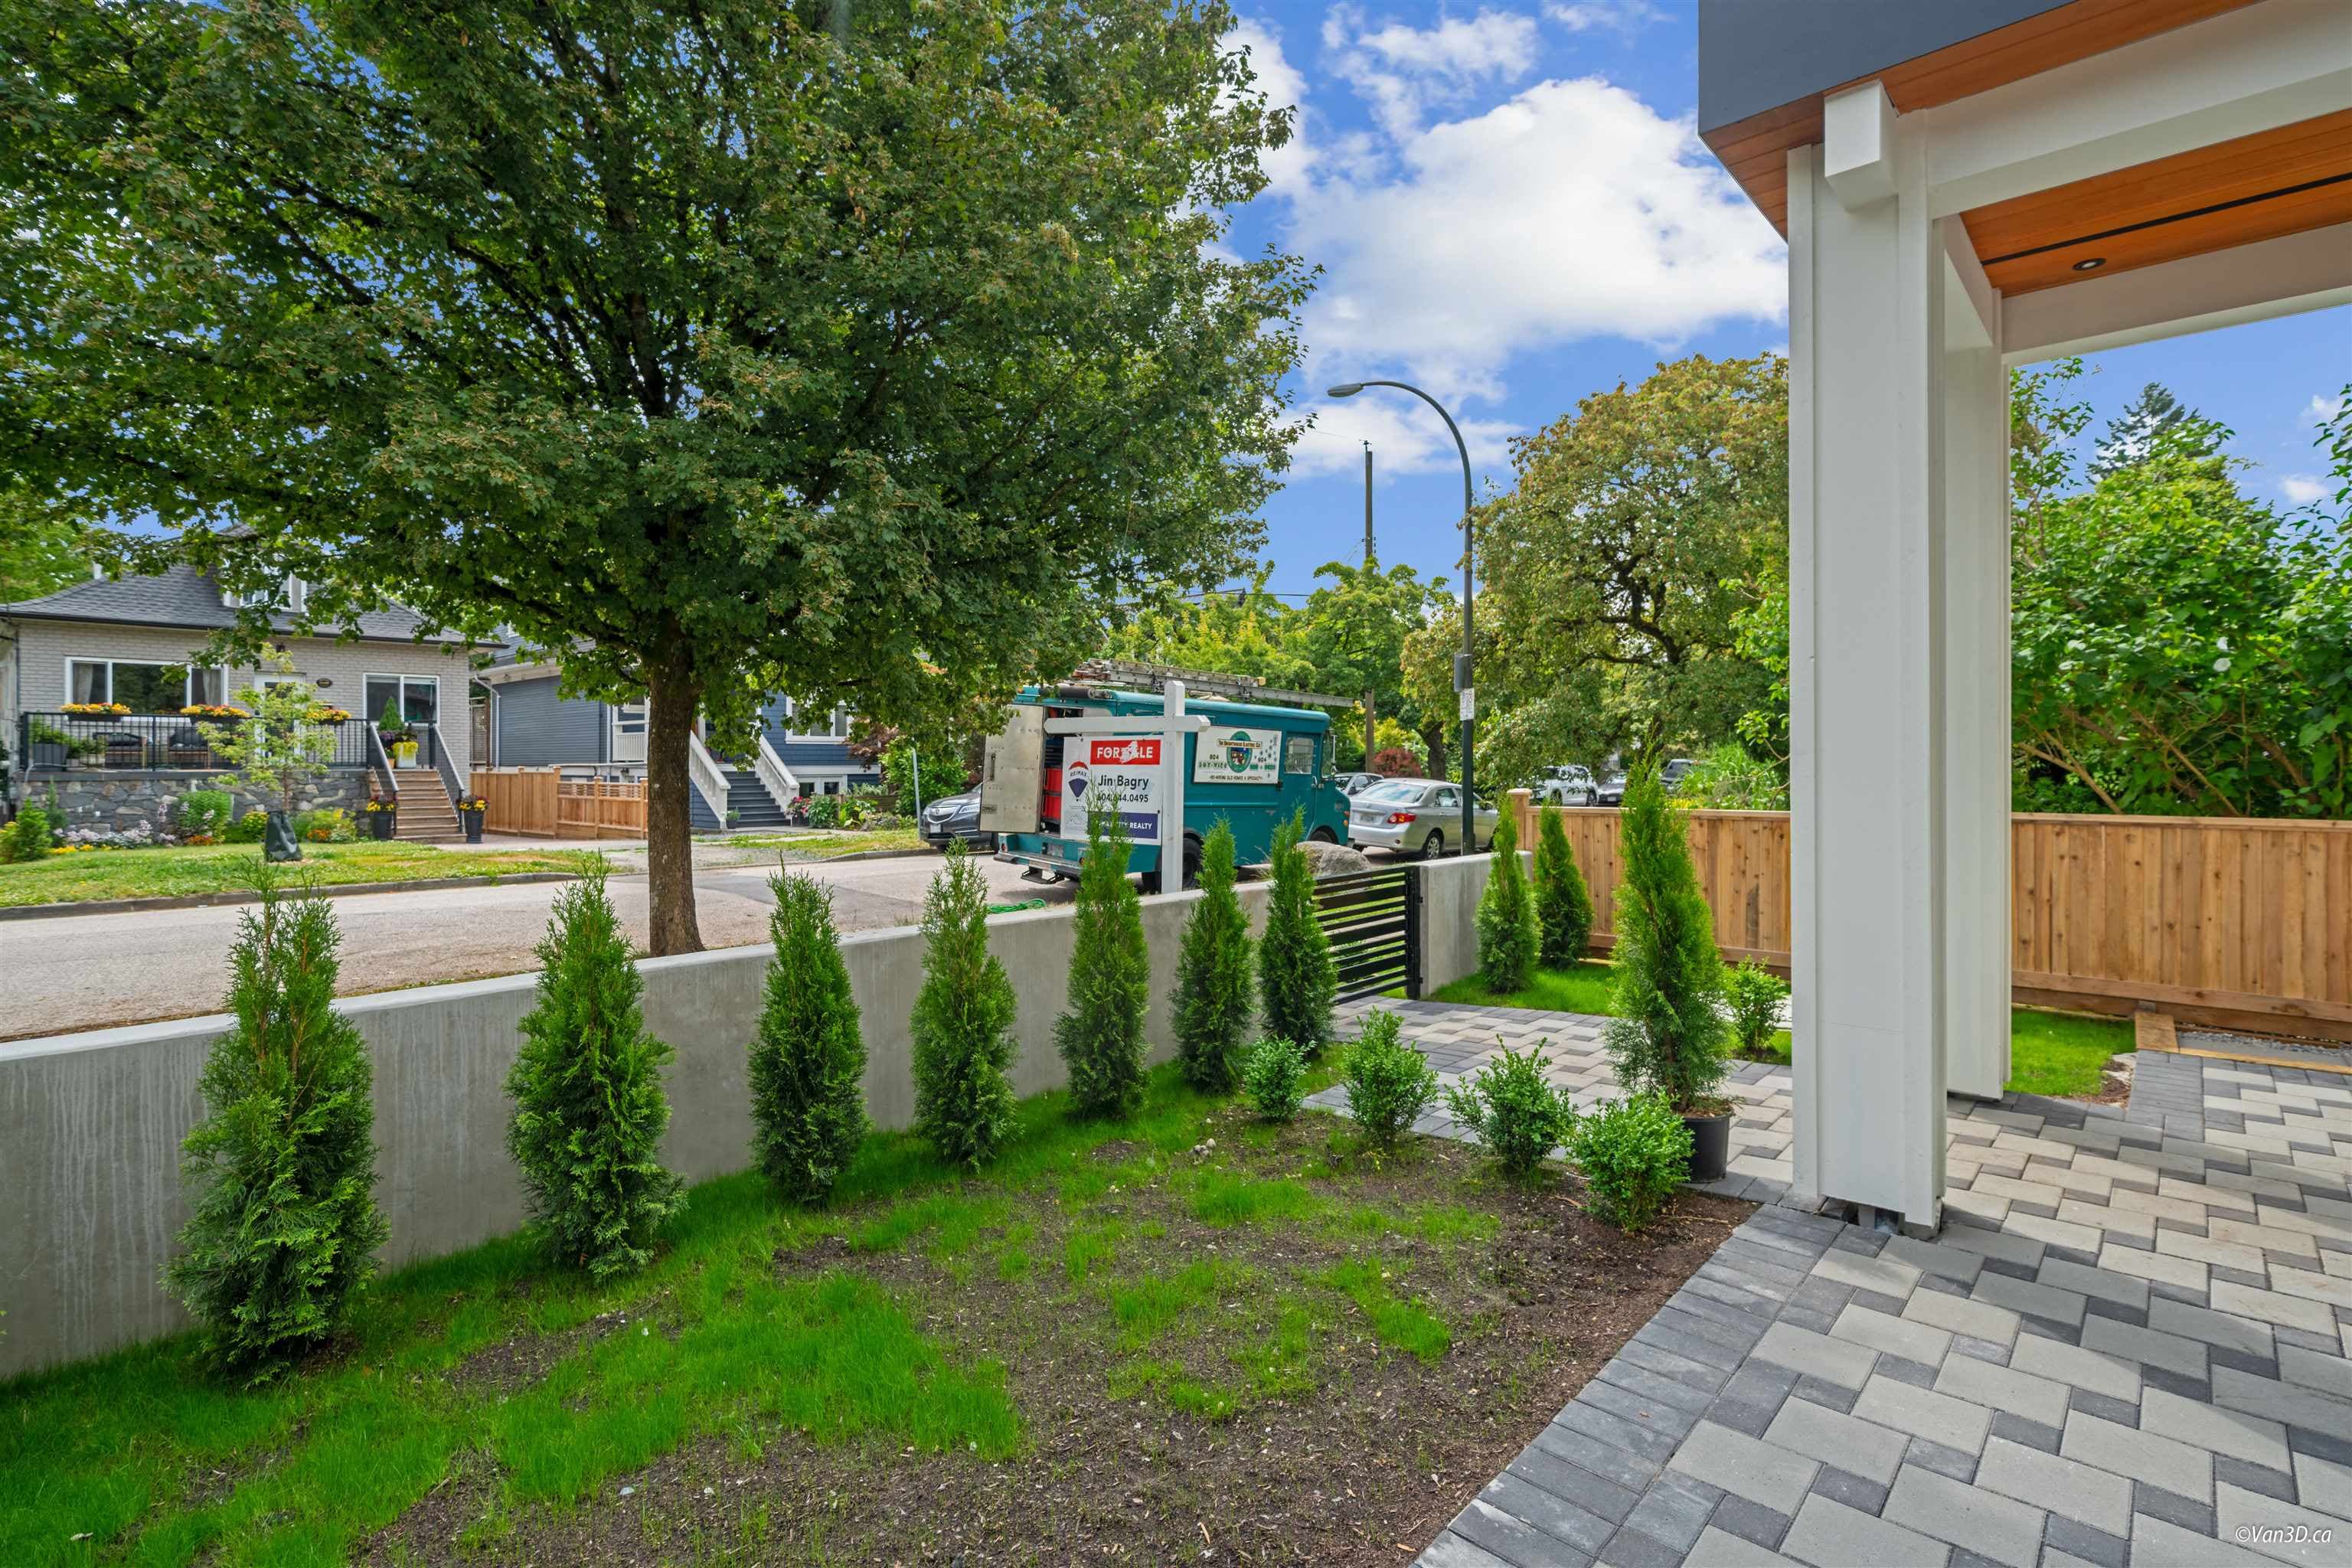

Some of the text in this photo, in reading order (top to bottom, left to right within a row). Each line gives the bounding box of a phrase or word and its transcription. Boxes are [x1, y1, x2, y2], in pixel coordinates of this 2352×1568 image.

[1096, 746, 1119, 759] FOR
[1098, 775, 1149, 790] Jin Bagry
[1129, 822, 1152, 830] REALTY
